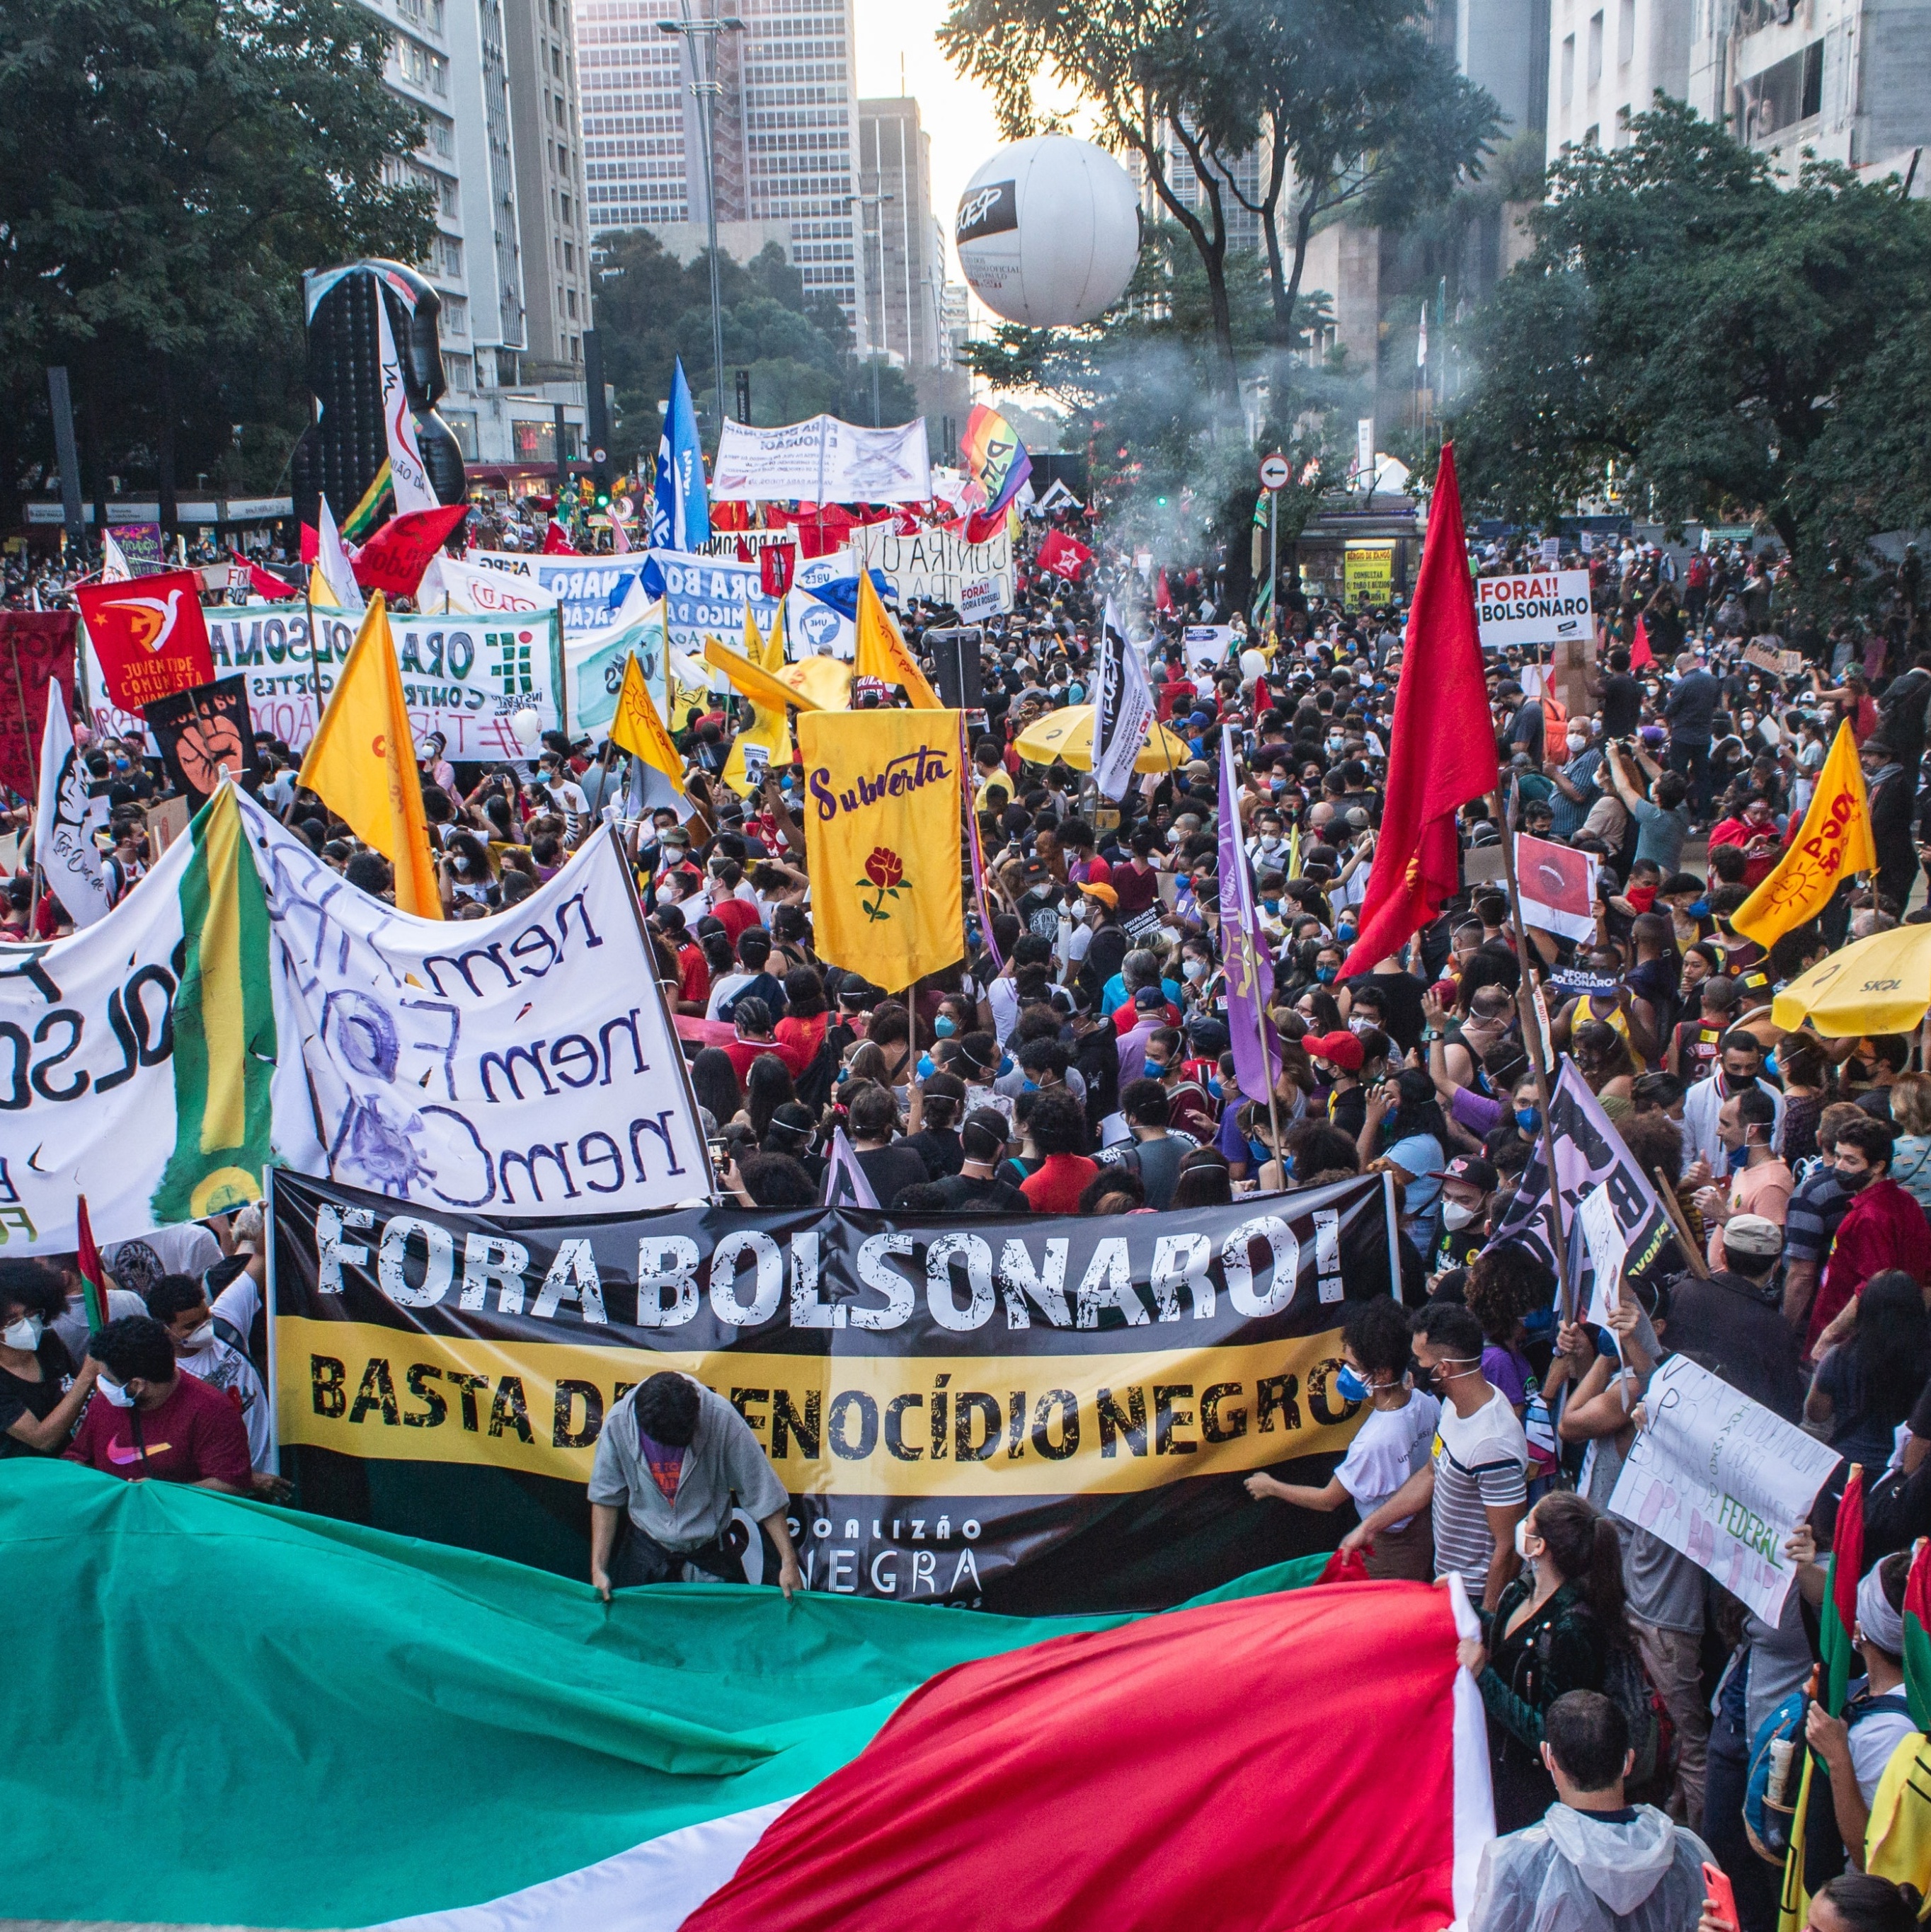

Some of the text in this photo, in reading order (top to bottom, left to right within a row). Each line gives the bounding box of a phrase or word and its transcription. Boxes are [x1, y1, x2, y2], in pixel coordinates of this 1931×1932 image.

[961, 584, 990, 601] FORA!!
[1480, 577, 1559, 602] FORA!!
[1482, 597, 1588, 622] BOLSONARO
[810, 744, 952, 821] Subverta
[1818, 847, 1840, 877] 50
[1041, 914, 1059, 923] ONLY
[1563, 969, 1598, 980] #FORA
[1860, 980, 1902, 991] SKOL
[317, 1203, 1344, 1332] FORA BOLSONARO!
[310, 1353, 534, 1444] BASTA
[1097, 1359, 1363, 1459] NEGRO
[785, 1514, 981, 1539] COALIZÃO
[1718, 1493, 1784, 1570] FEDERAL
